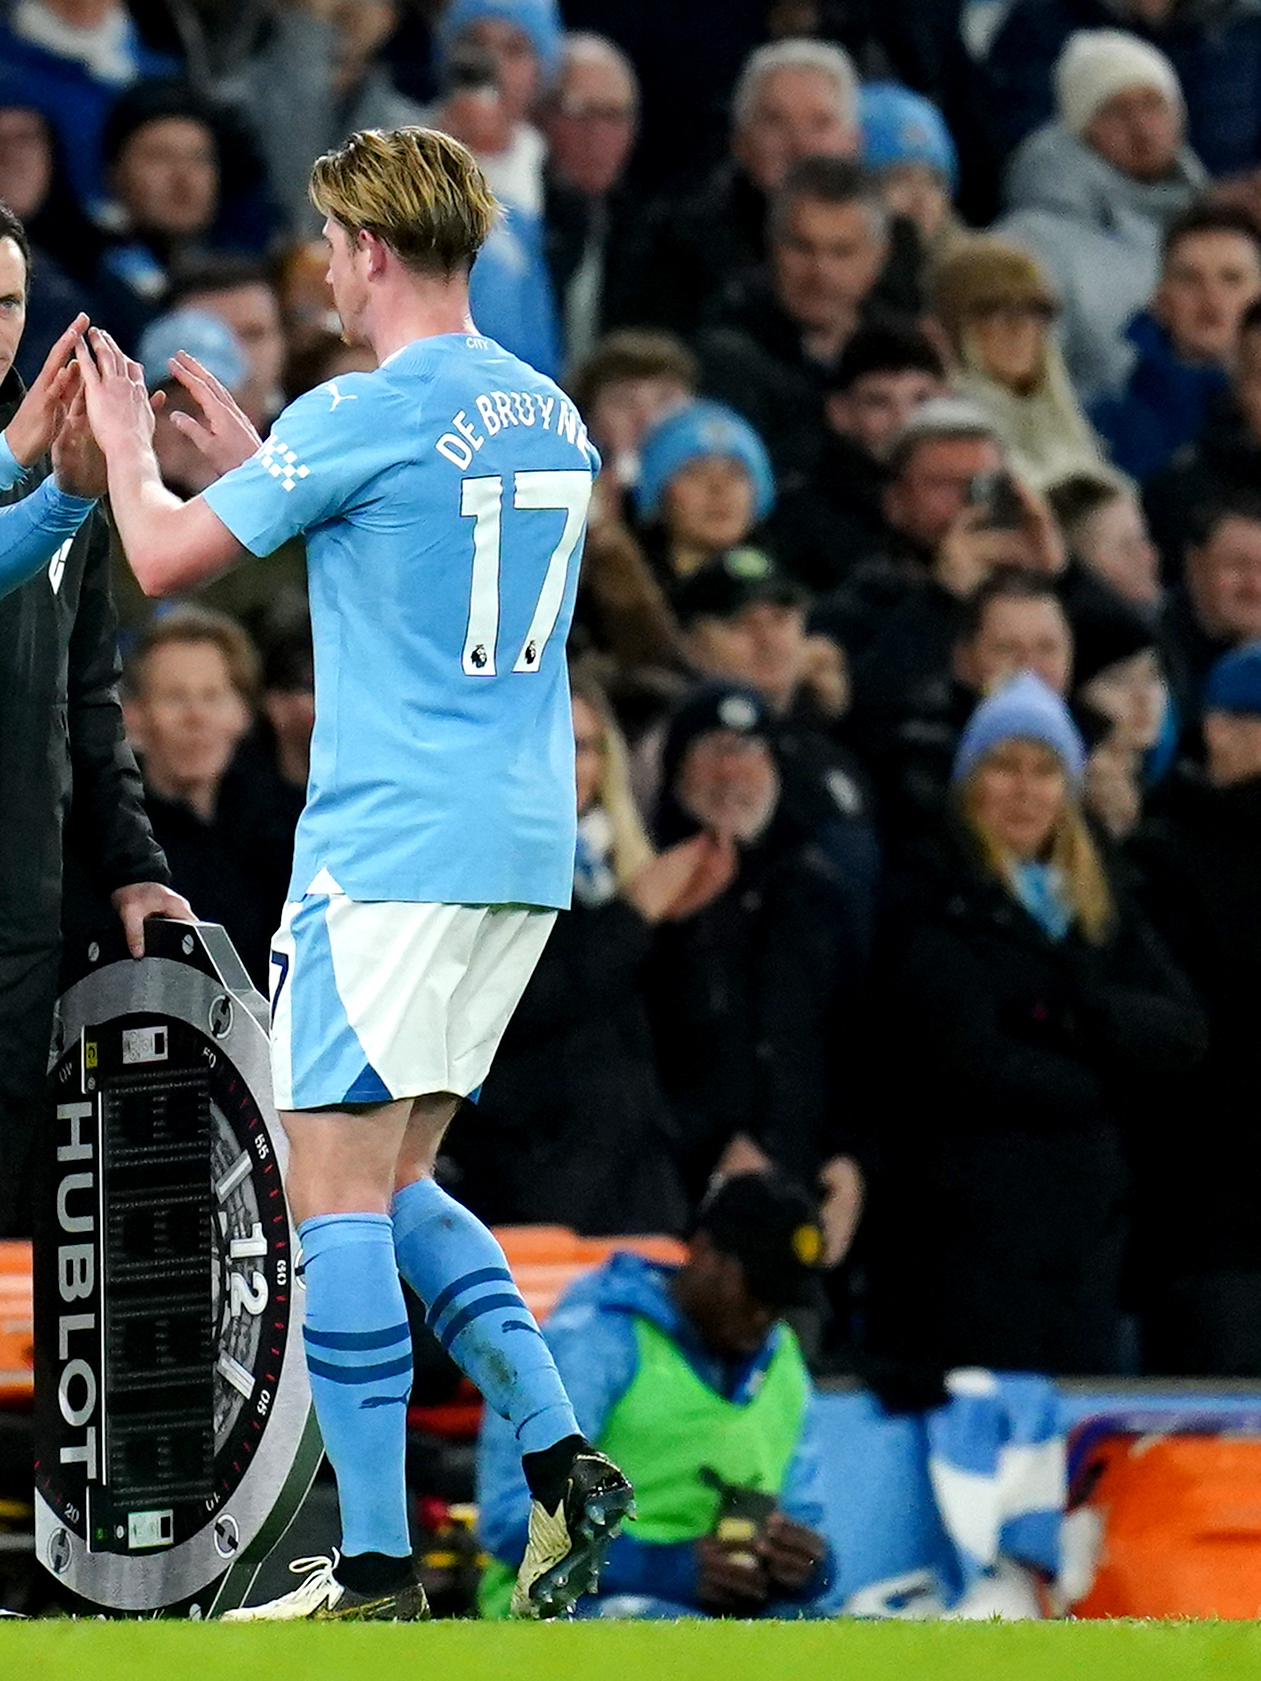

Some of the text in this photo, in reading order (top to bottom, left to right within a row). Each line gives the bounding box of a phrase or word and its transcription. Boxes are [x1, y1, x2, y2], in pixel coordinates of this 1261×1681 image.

[466, 337, 489, 350] CITY
[435, 409, 485, 471] DE
[459, 467, 593, 677] 17
[270, 949, 289, 1031] 7
[254, 1133, 270, 1160] 55
[56, 1101, 97, 1479] HUBLOT
[230, 1222, 269, 1317] 12
[276, 1259, 287, 1286] 60
[257, 1389, 271, 1416] 05
[64, 1502, 80, 1524] 20
